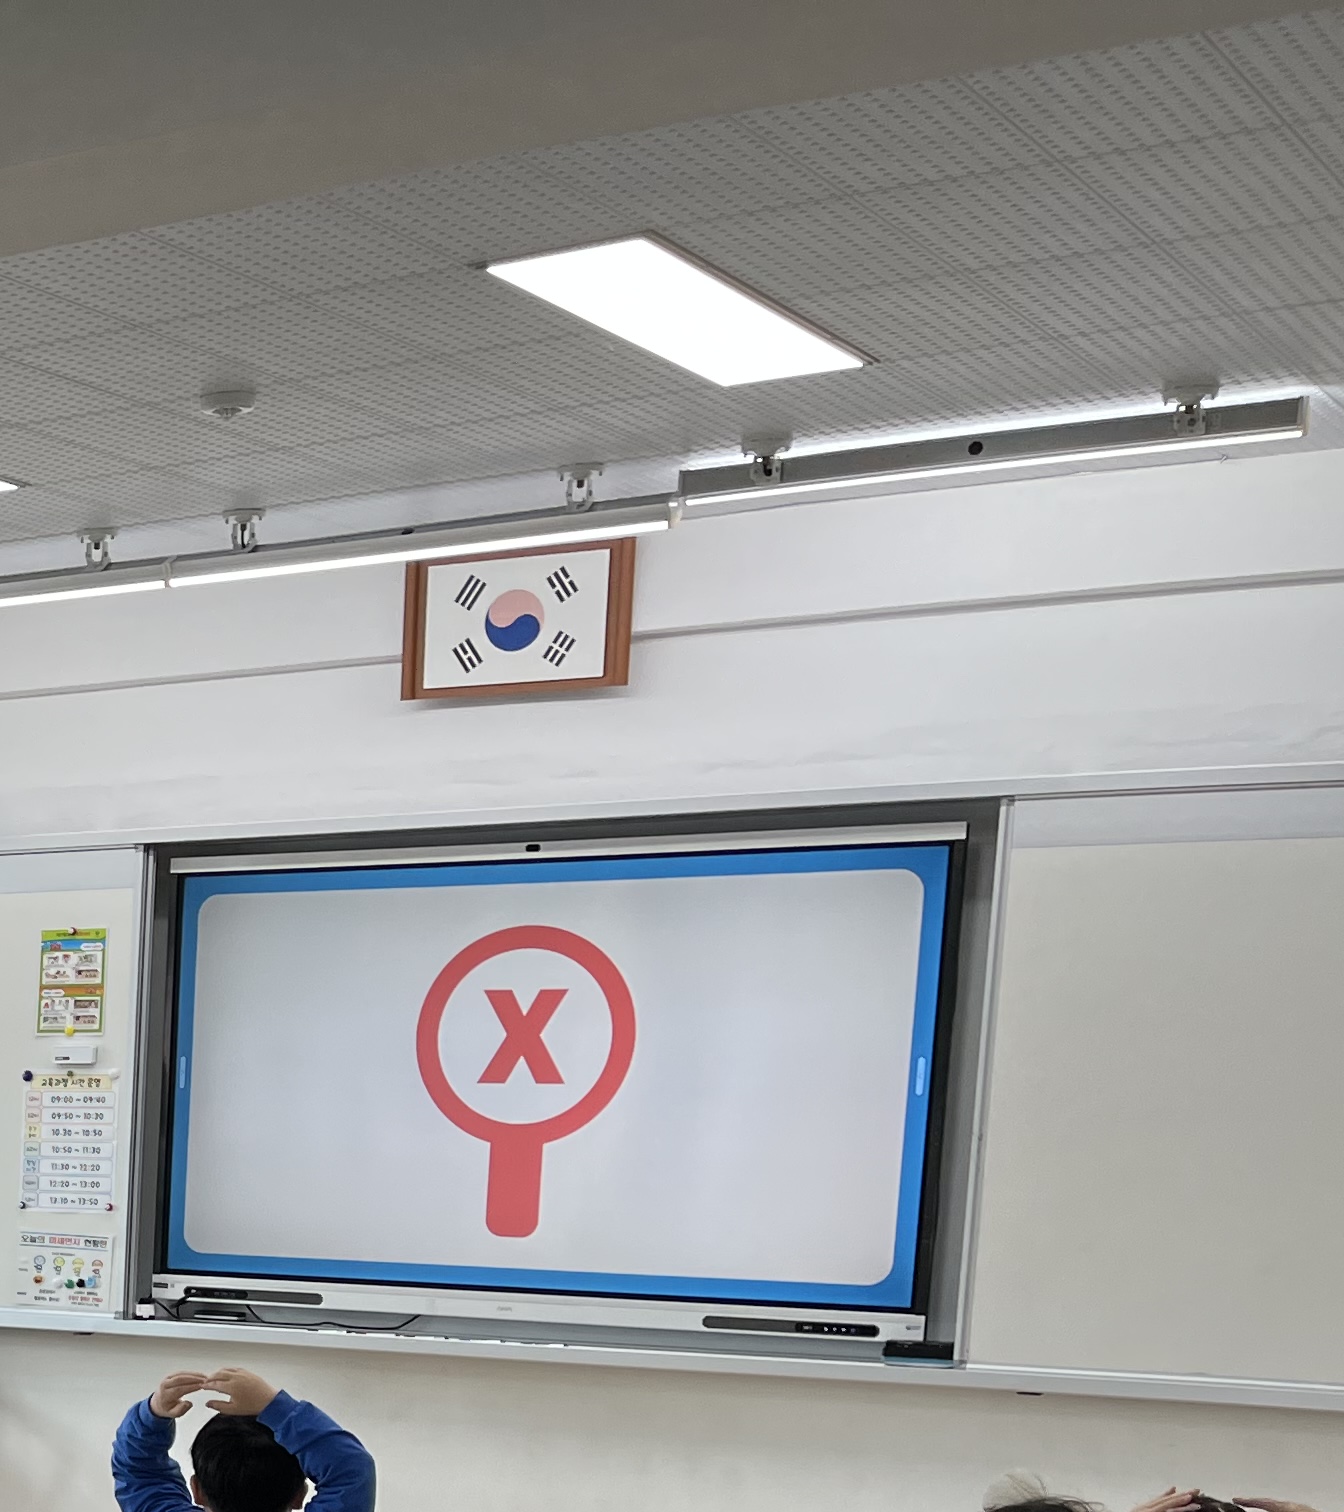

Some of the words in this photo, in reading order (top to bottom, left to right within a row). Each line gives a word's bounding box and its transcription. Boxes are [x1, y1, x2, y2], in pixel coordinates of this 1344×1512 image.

[477, 988, 569, 1084] X
[70, 1078, 85, 1088] 시간
[21, 1234, 46, 1244] 오늘의
[48, 1236, 81, 1246] 미세먼지
